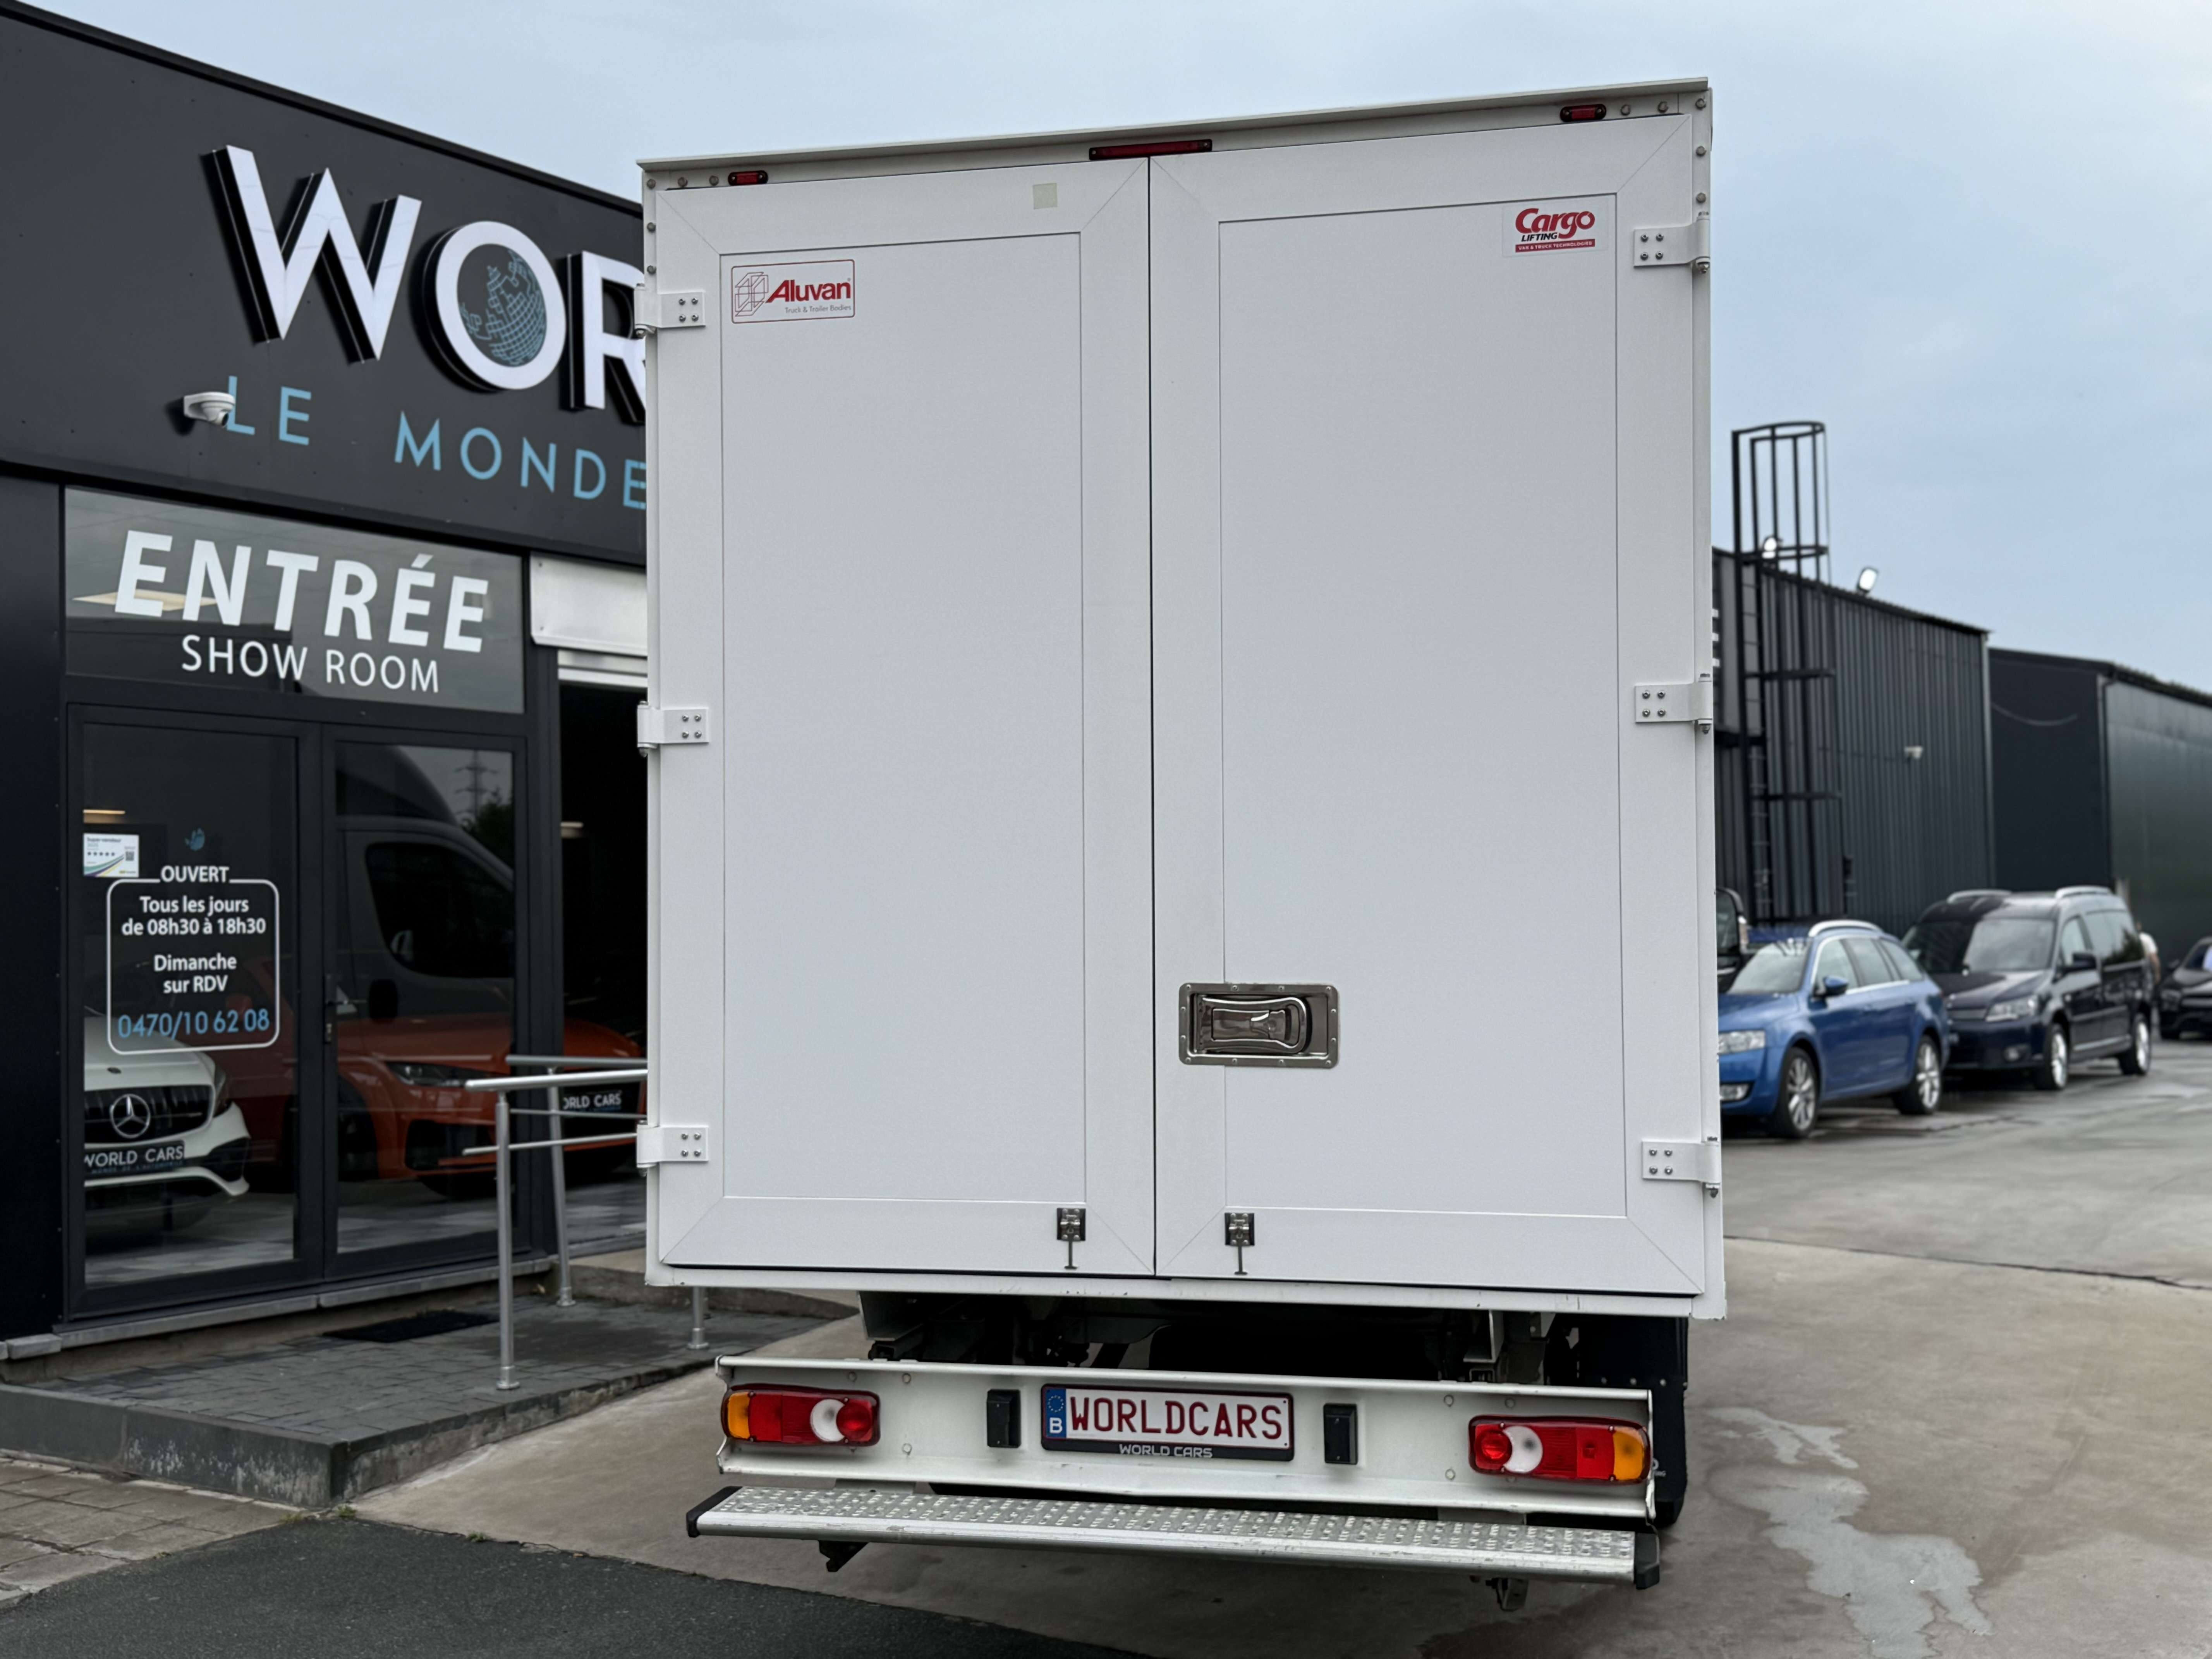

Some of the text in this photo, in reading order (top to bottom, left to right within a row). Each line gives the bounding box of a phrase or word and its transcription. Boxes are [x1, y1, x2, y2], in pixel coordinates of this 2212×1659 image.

[1515, 208, 1595, 239] Cargo
[1521, 232, 1558, 242] LIFTING
[765, 279, 851, 303] Aluvan
[227, 375, 646, 510] LE MONDE
[114, 530, 489, 653] ENTRÉE
[182, 634, 439, 693] SHOW ROOM
[161, 865, 229, 883] OUVERT
[140, 896, 249, 917] Tous les jours
[122, 917, 266, 936] de 08h30 à 18h30
[153, 953, 237, 972] Dimanche
[163, 975, 228, 994] sur RDV
[118, 1008, 270, 1040] 0470/10 62 08
[594, 1092, 622, 1107] CARS
[84, 1146, 184, 1168] WORLD CARS
[1049, 1396, 1282, 1439] B WORLDCARS
[1119, 1444, 1213, 1458] WORLD CARS
